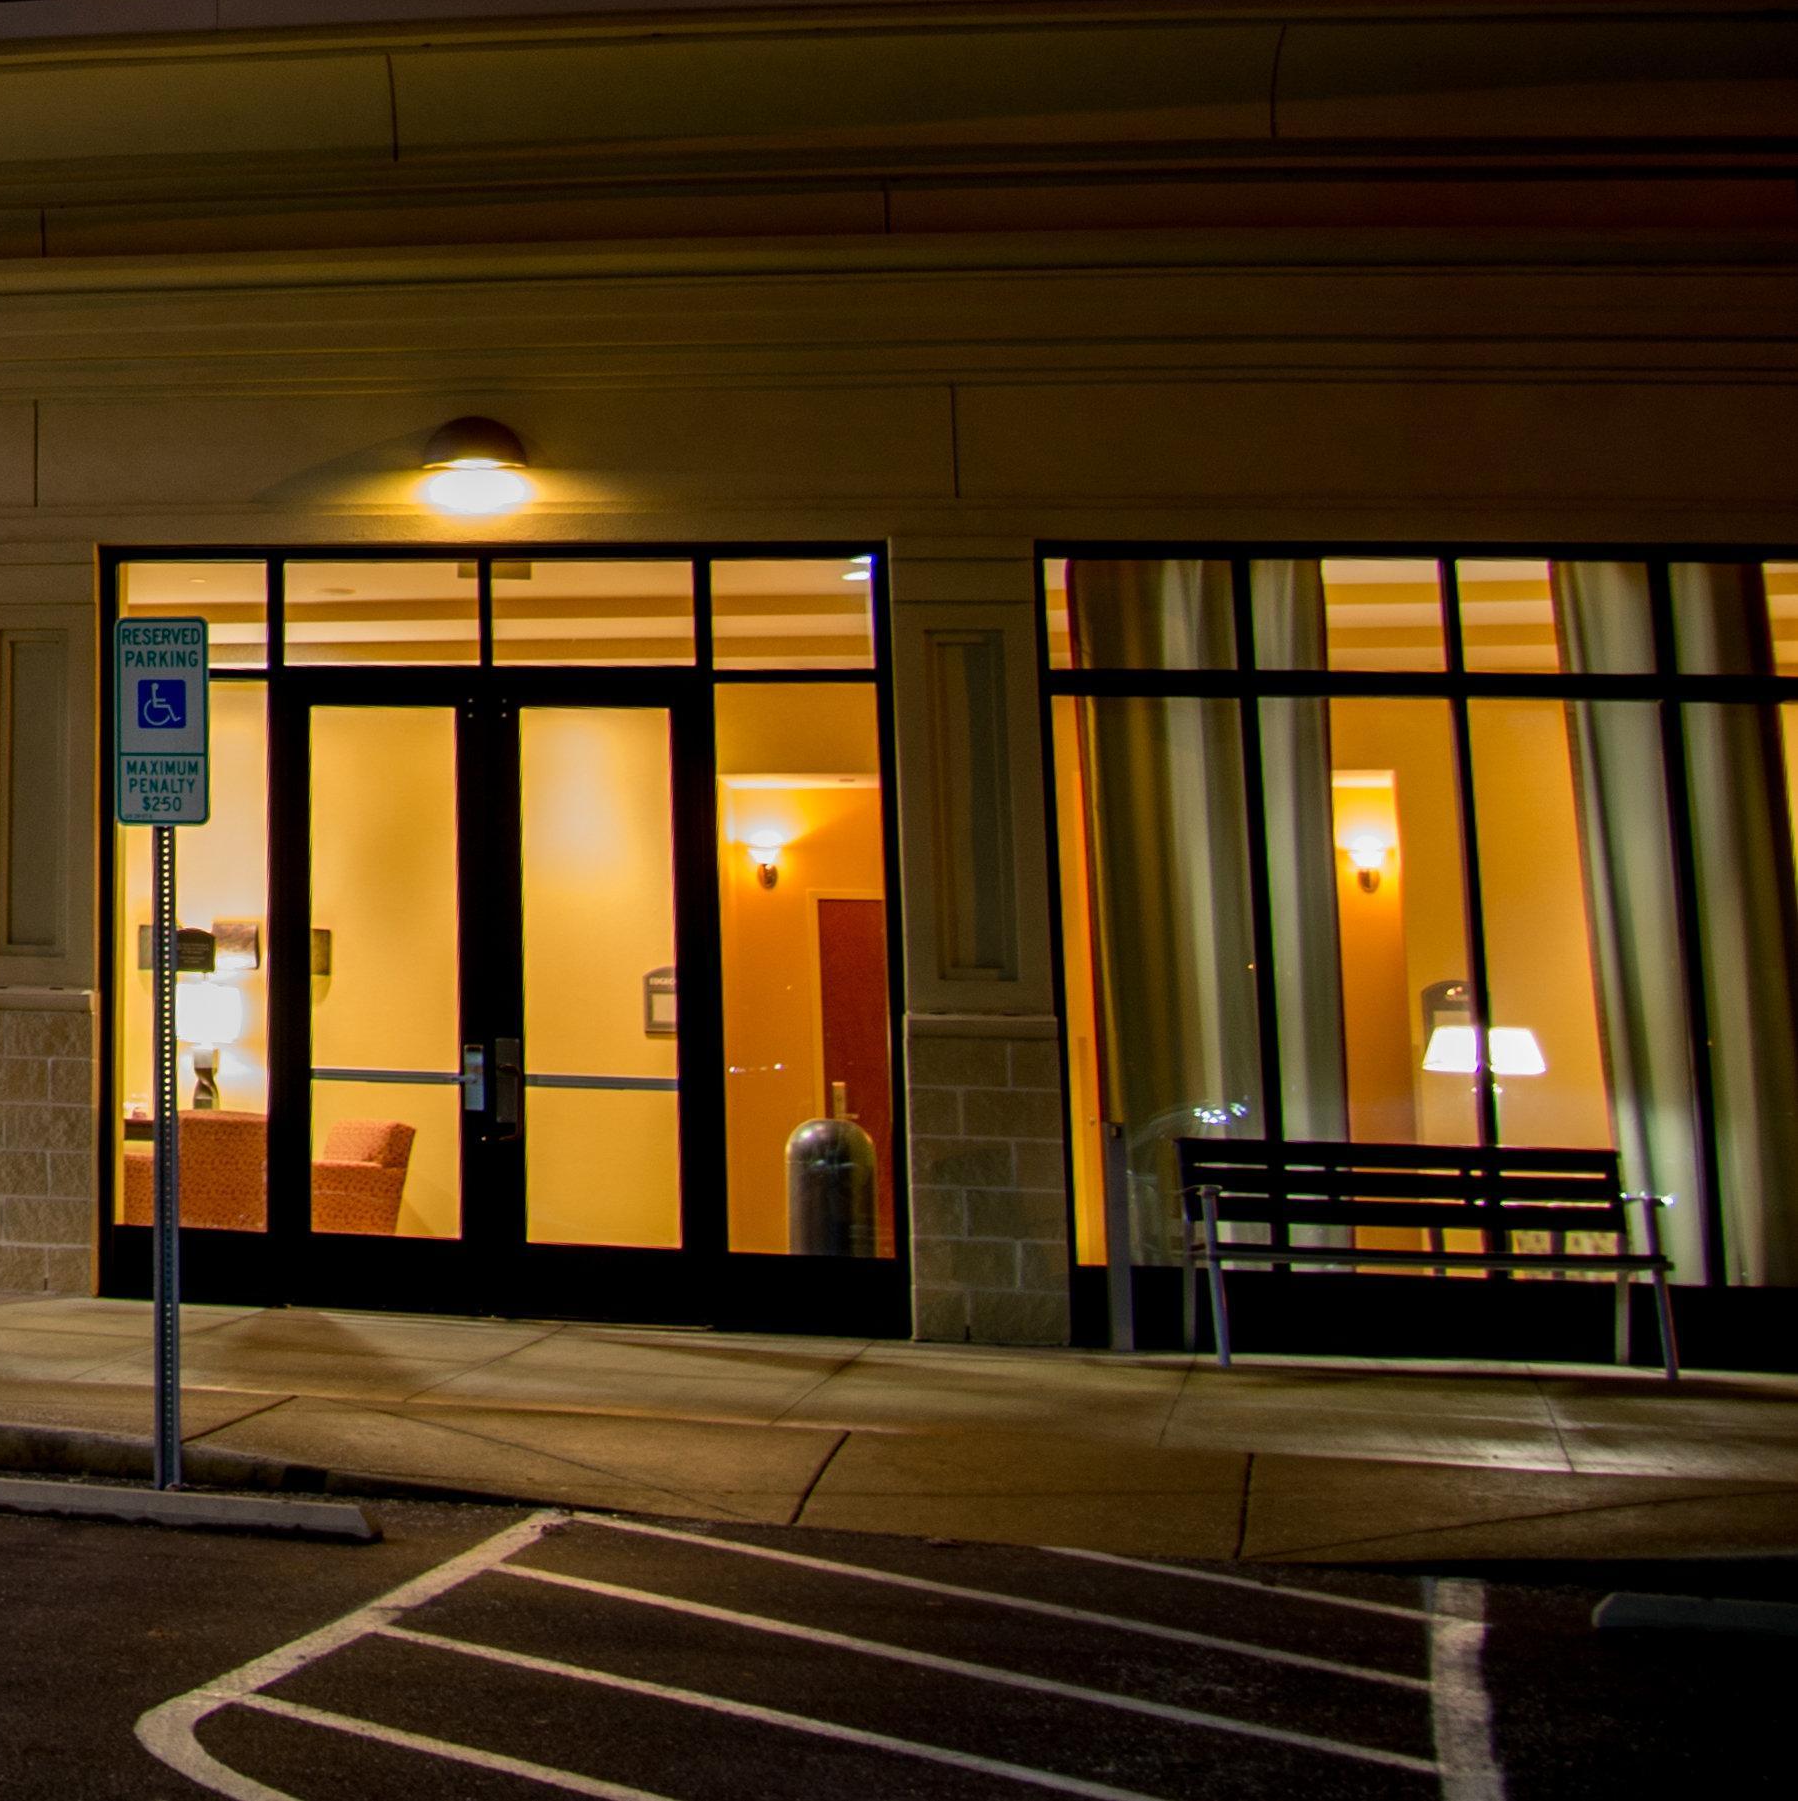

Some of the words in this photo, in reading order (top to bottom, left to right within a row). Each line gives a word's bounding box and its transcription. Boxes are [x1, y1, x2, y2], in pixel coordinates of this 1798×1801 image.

[122, 628, 201, 646] RESERVED
[124, 651, 199, 669] PARKING
[126, 760, 199, 776] MAXIMUM
[129, 777, 196, 794] PENALTY
[141, 796, 183, 812] $250
